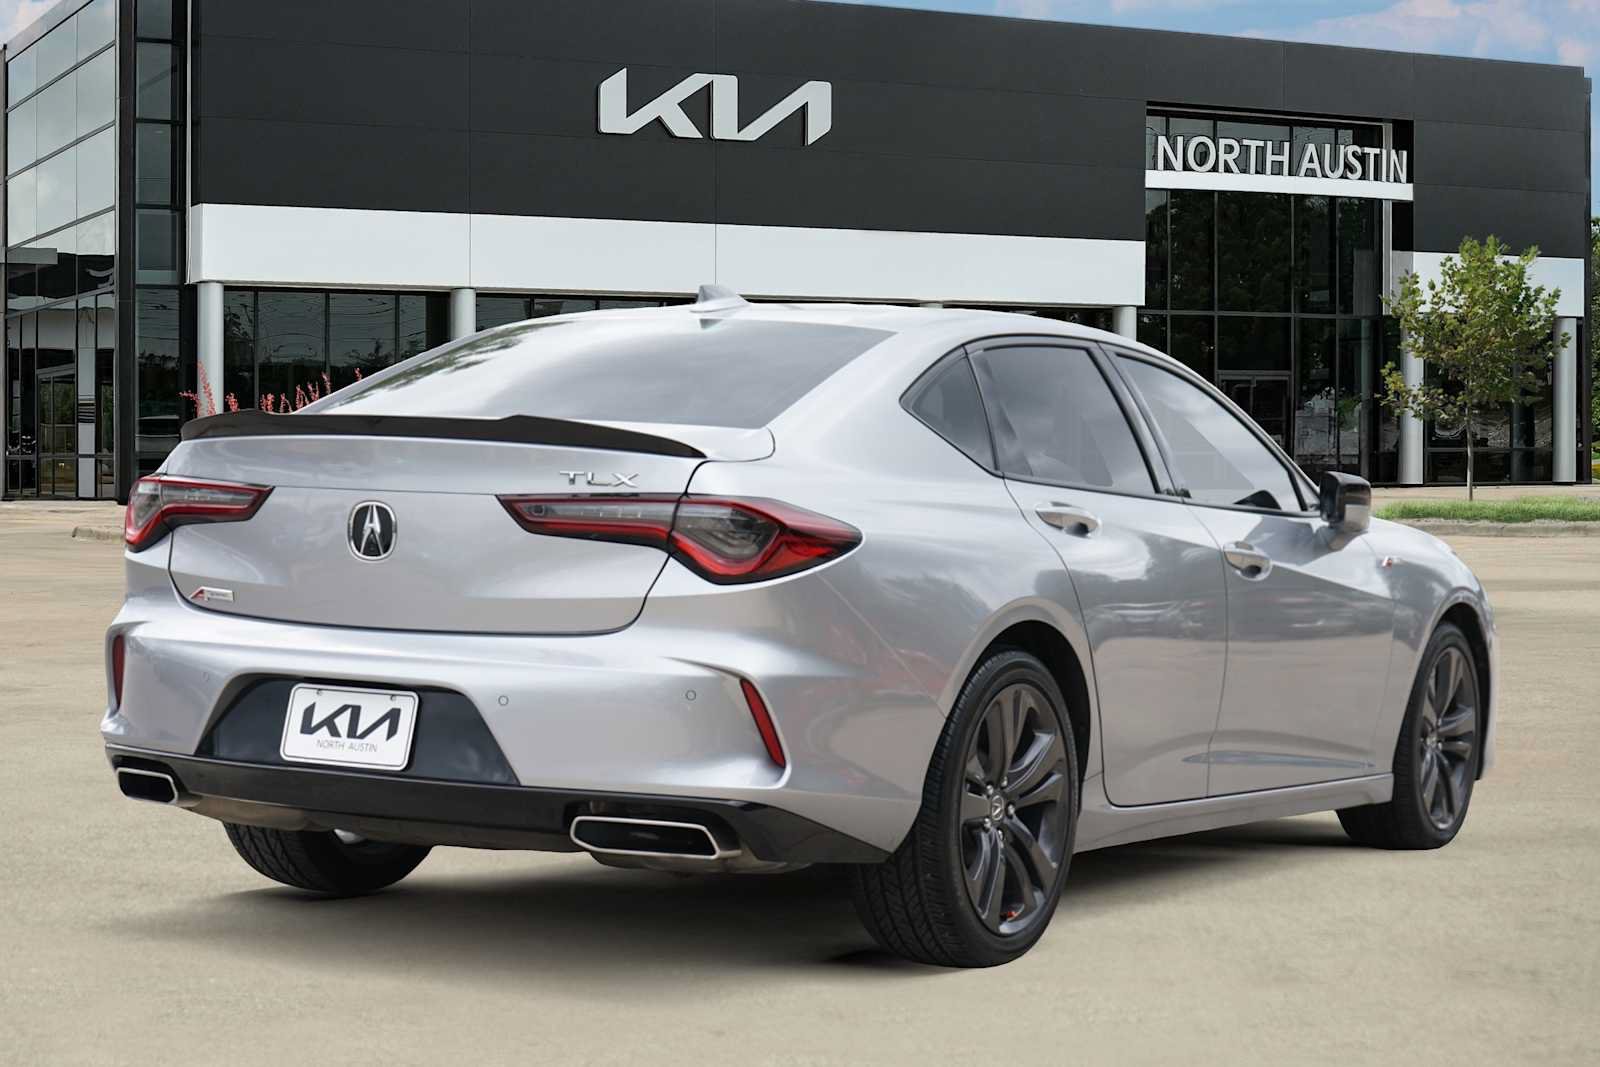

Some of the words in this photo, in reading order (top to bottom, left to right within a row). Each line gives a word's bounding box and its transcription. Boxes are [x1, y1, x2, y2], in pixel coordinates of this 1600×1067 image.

[598, 67, 832, 146] KIA
[1157, 135, 1291, 177] NORTH
[1299, 143, 1408, 184] AUSTIN
[559, 470, 640, 489] TLX
[300, 702, 402, 741] KIA
[316, 740, 345, 751] NORTH
[348, 742, 378, 753] AUSTIN
